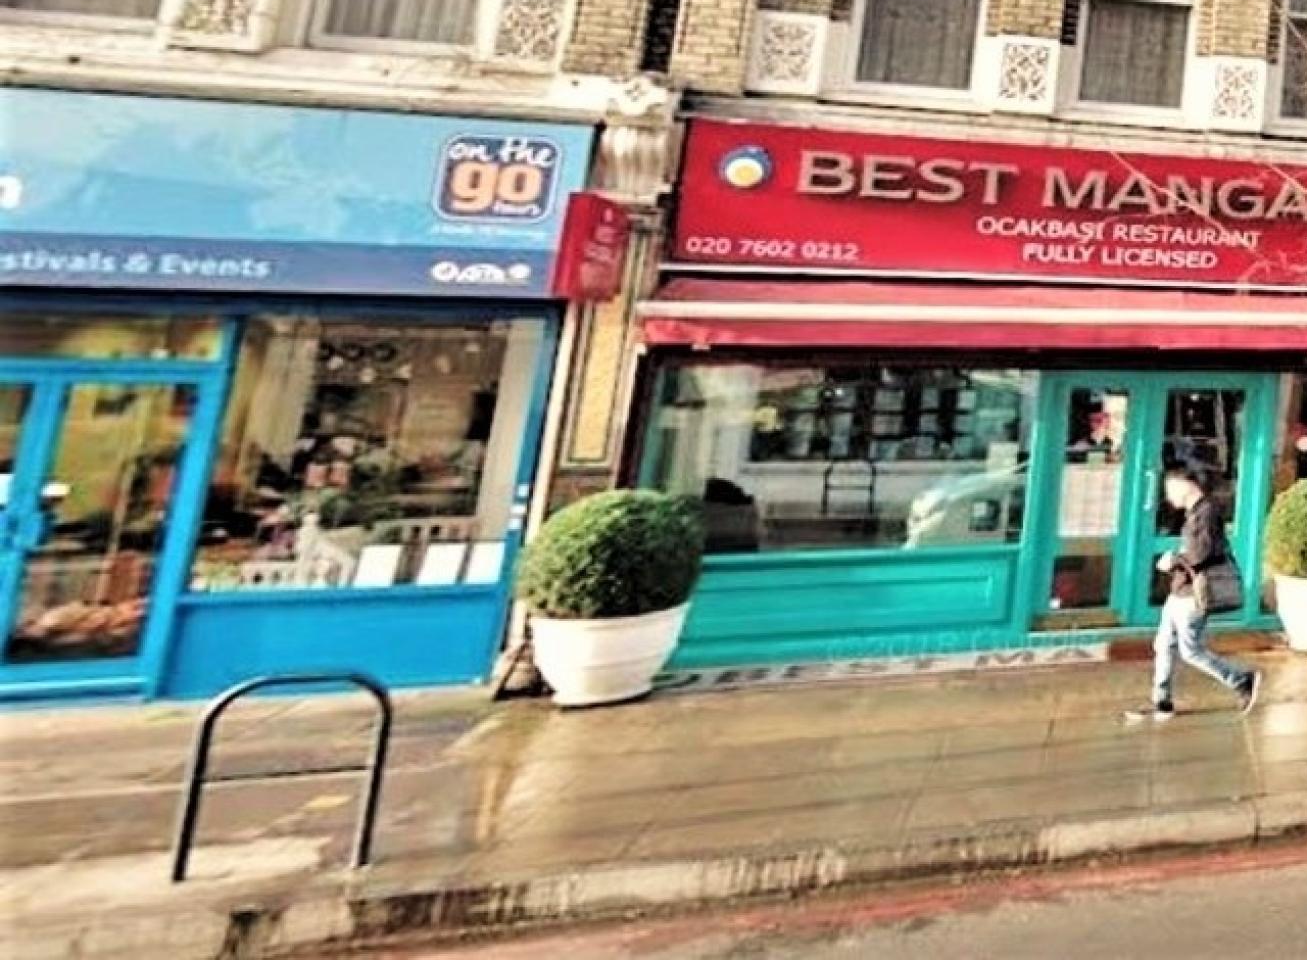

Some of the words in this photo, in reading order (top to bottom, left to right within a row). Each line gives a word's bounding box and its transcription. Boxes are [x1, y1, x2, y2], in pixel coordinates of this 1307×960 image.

[451, 160, 543, 213] go
[796, 150, 1018, 206] BEST
[685, 236, 732, 255] 020
[738, 238, 796, 258] 7602
[801, 241, 860, 261] 0212
[1112, 223, 1262, 248] RESTAURANT
[123, 252, 149, 273] &
[159, 252, 272, 278] Events
[1022, 242, 1095, 265] FULLY
[1102, 246, 1219, 269] LICENSED
